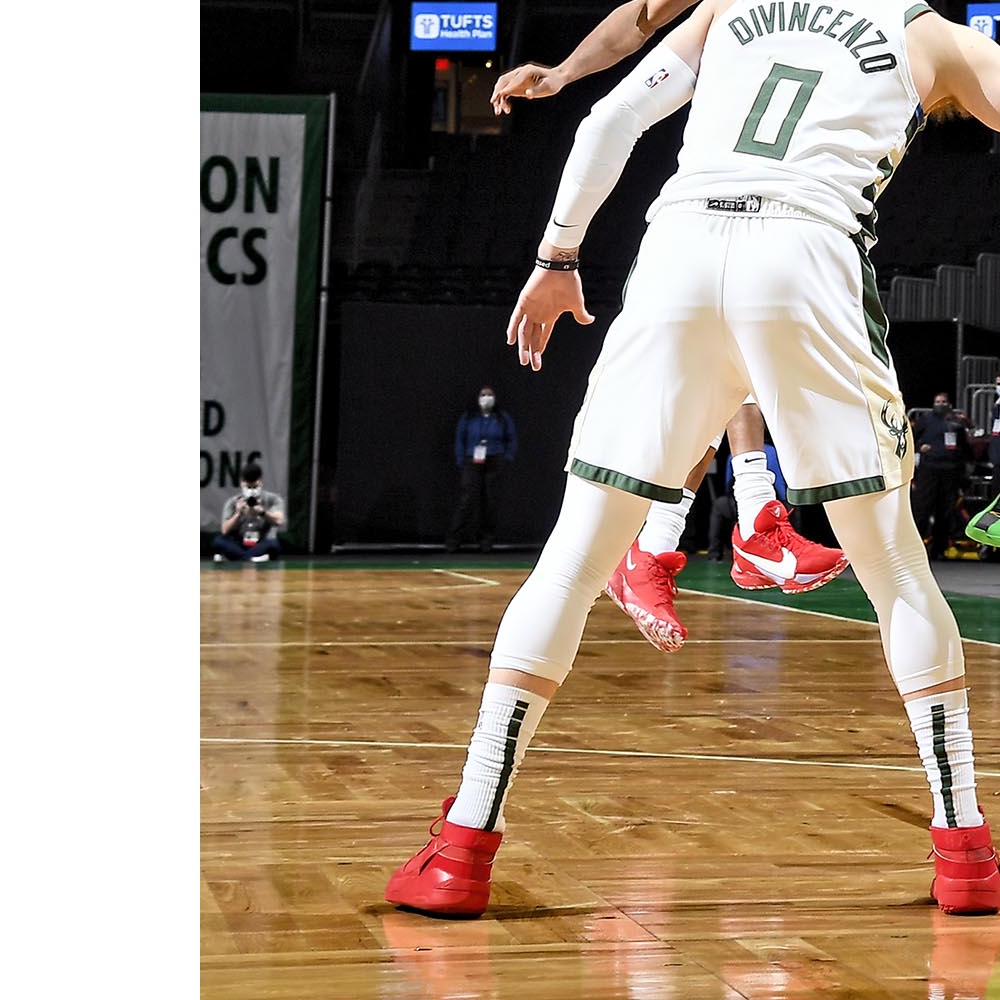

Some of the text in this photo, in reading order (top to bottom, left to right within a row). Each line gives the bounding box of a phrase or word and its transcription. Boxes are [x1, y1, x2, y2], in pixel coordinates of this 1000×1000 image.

[440, 14, 494, 29] TUFTS
[728, 1, 897, 74] DIVINCENZO
[733, 62, 823, 161] 0
